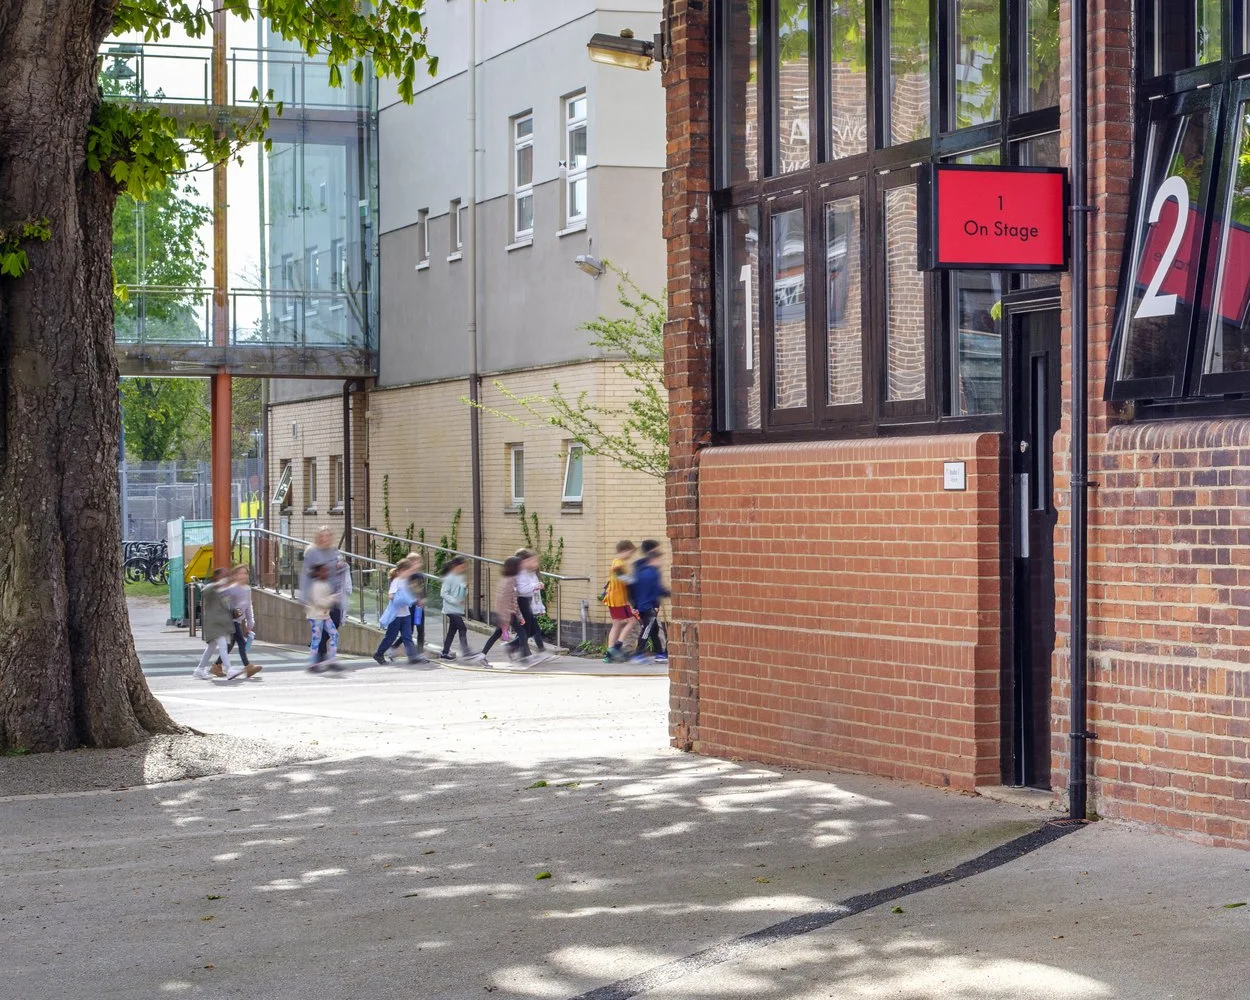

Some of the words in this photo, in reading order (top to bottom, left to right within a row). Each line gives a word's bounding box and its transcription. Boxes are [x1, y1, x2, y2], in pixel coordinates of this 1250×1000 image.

[963, 219, 989, 236] On
[993, 220, 1039, 242] Stage
[997, 195, 1003, 211] 1
[1134, 175, 1190, 319] 2
[739, 264, 753, 370] 1
